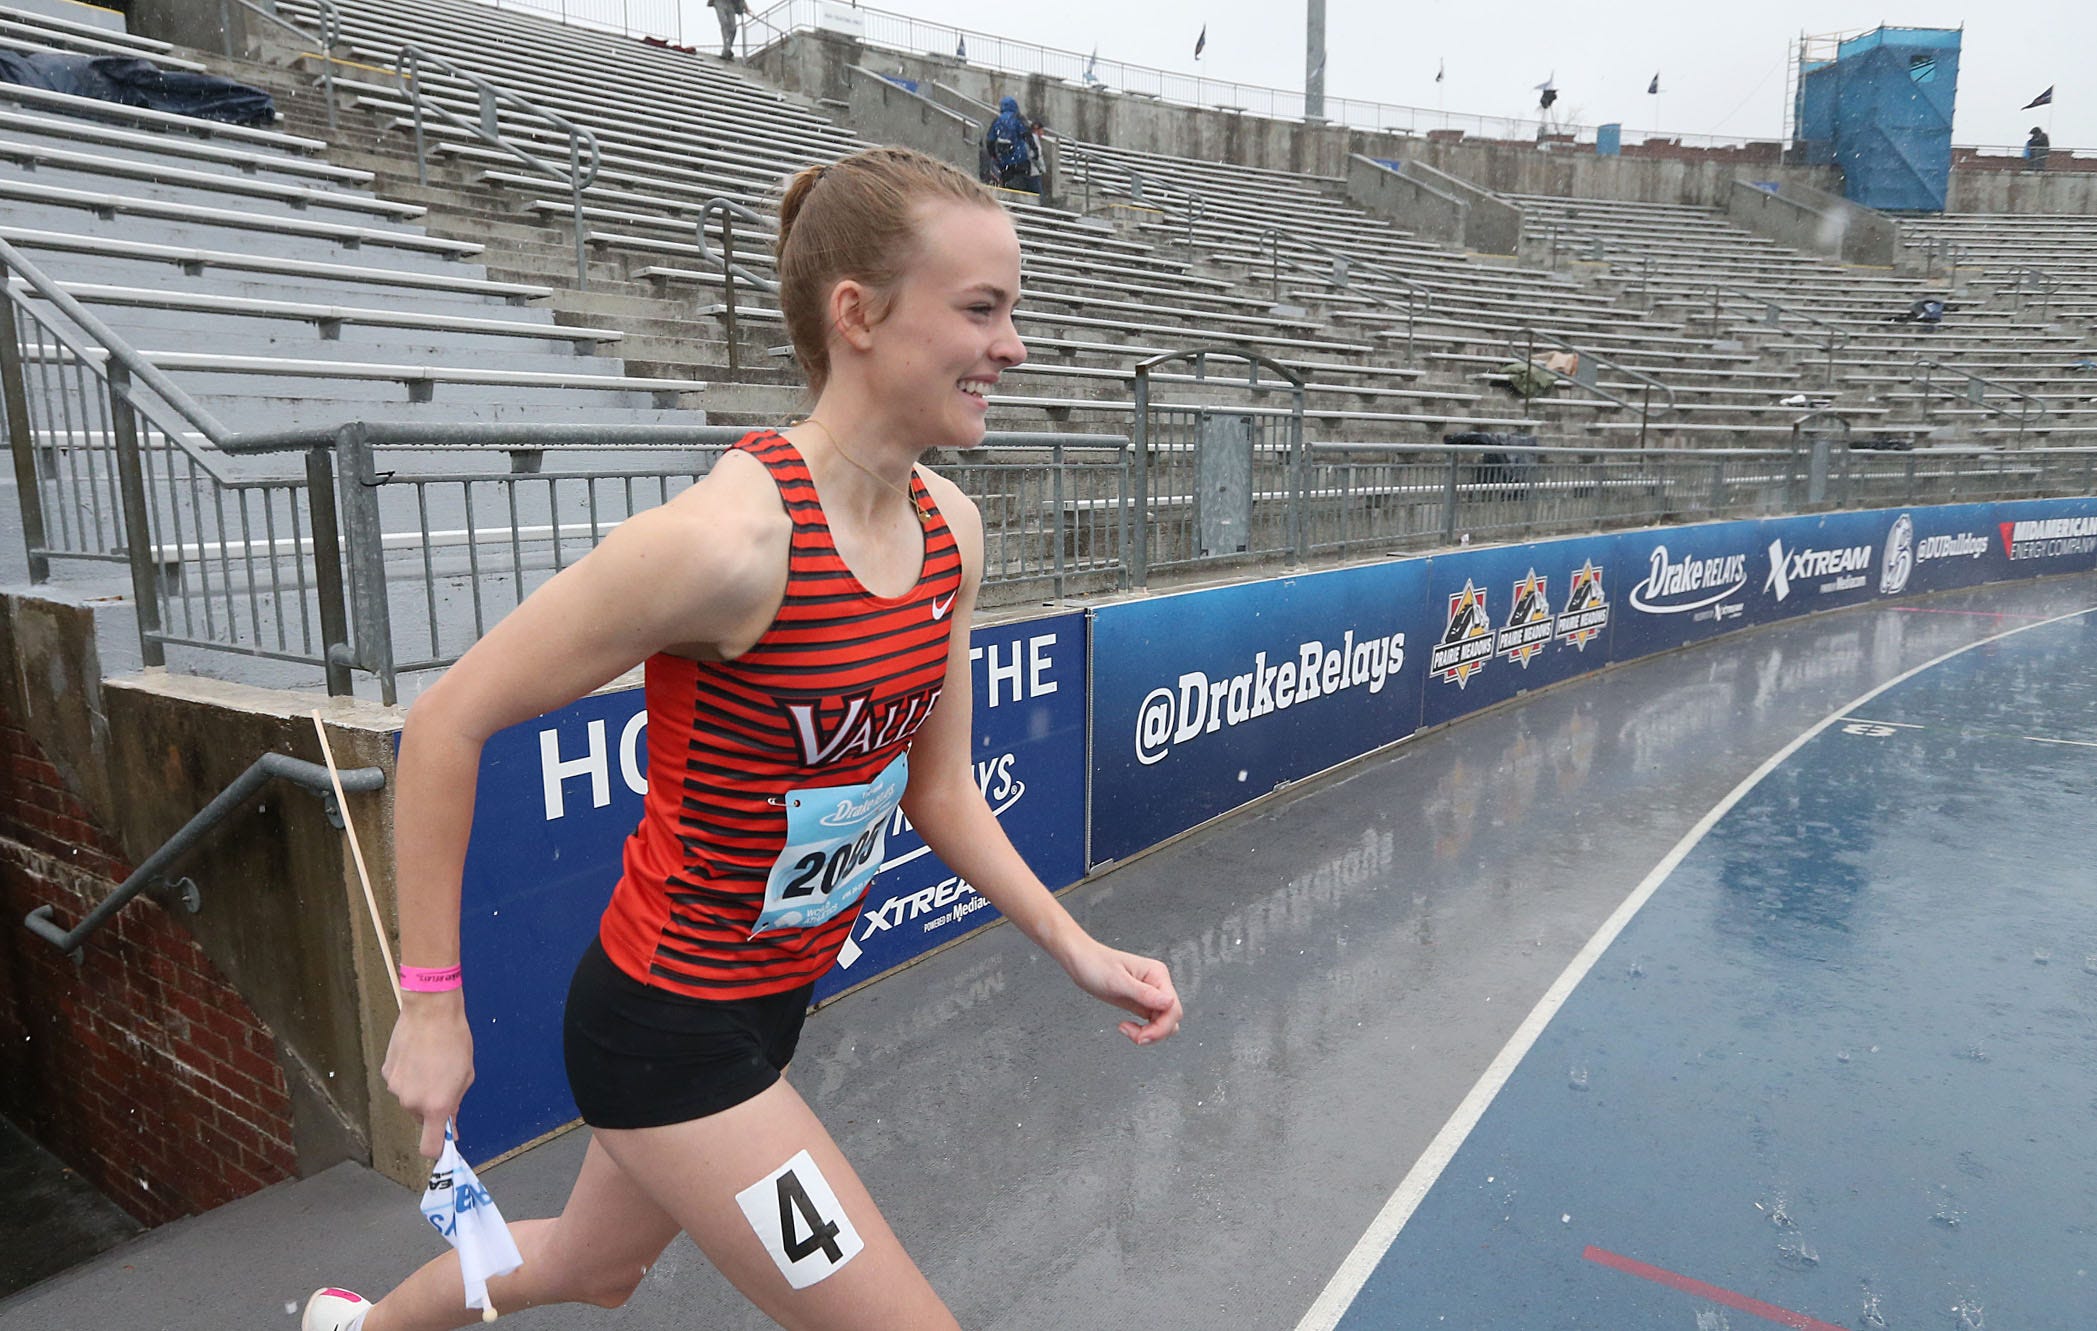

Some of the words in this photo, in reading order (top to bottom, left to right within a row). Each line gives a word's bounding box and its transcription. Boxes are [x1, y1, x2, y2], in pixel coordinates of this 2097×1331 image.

[1790, 546, 1872, 580] XTREAM
[1916, 533, 1989, 563] @DUBulldogs
[1645, 545, 1702, 600] Drake
[1702, 553, 1746, 587] RELAYS
[1500, 628, 1523, 647] PRAIRIE
[1523, 622, 1551, 641] MEADOWS
[1558, 614, 1581, 632] PRAIRIE
[1433, 644, 1460, 670] PRAIRIE
[1460, 635, 1492, 660] MEADOWS
[1135, 630, 1406, 765] @DrakeRelays
[786, 688, 943, 767] VALLE
[860, 876, 977, 942] XTREA
[953, 896, 991, 922] Mediac
[776, 1168, 844, 1265] 4
